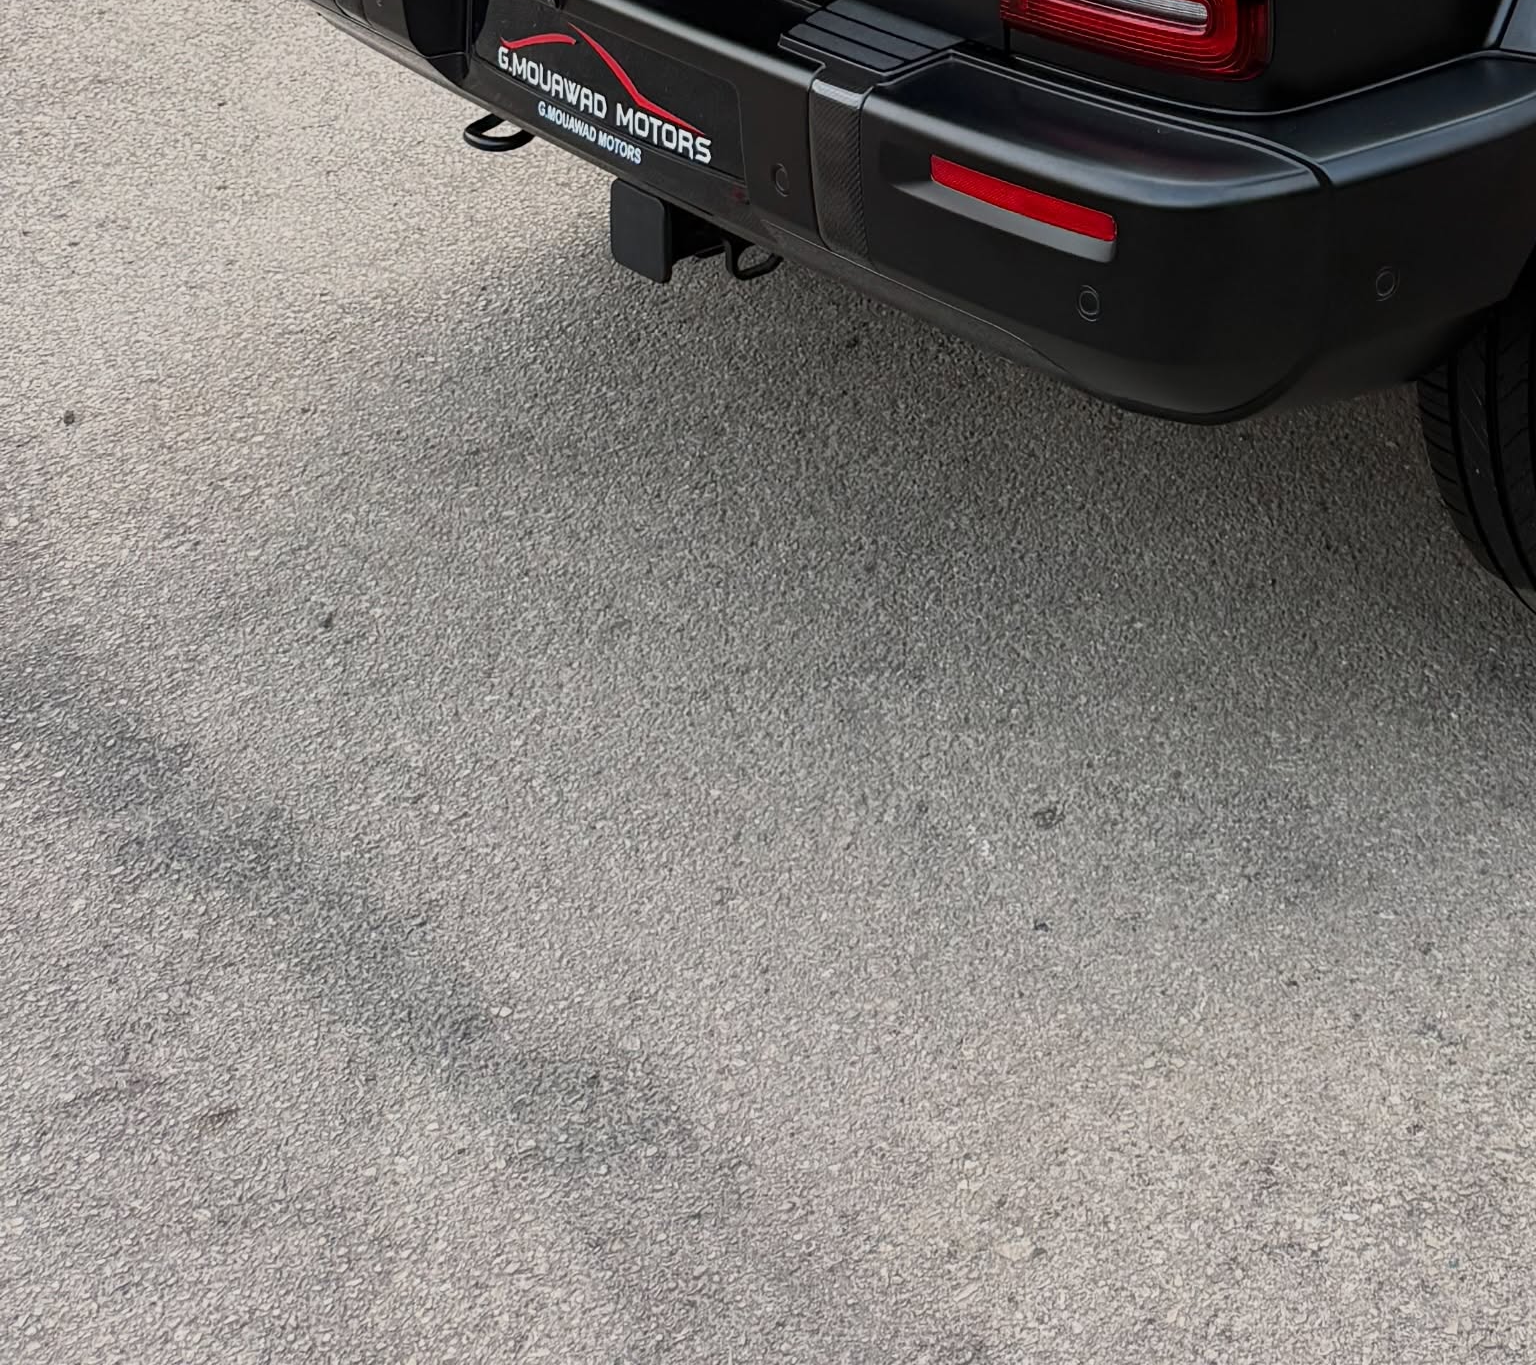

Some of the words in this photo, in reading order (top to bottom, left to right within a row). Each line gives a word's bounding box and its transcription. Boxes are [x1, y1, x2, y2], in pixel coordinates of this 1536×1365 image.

[498, 46, 608, 119] G.MOUAWAD
[615, 103, 712, 165] MOTORS
[537, 100, 597, 143] G.MOUAWAD
[599, 130, 642, 165] MOTORS
